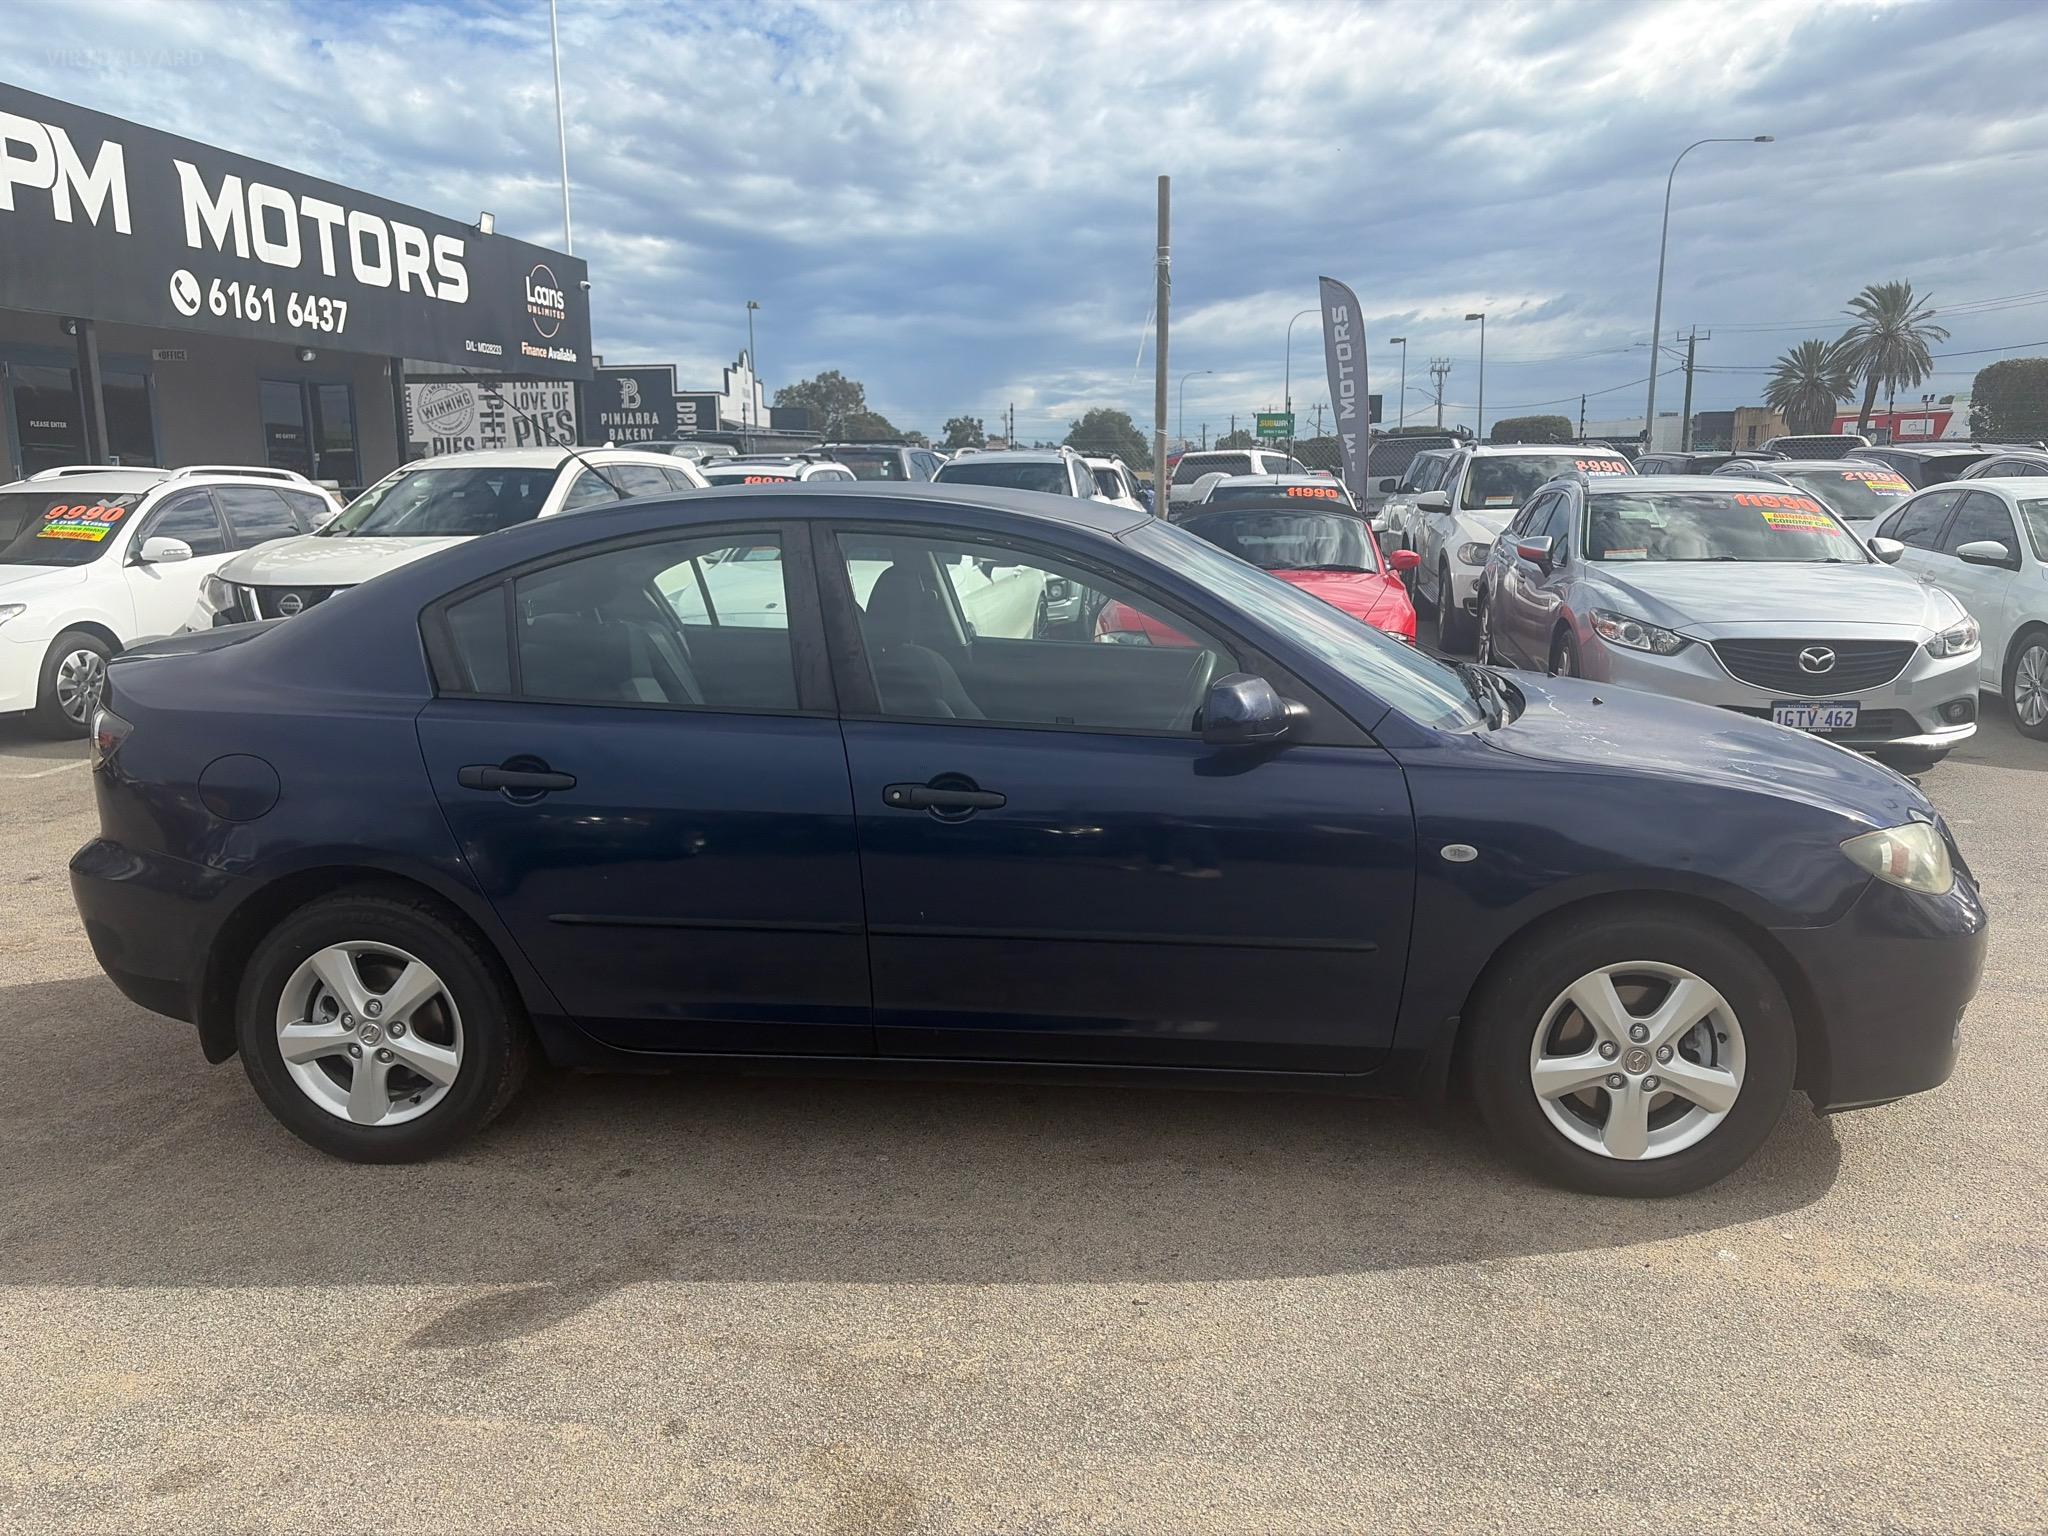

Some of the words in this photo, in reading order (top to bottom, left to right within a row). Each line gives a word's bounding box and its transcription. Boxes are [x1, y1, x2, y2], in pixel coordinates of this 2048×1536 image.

[173, 159, 470, 304] MOTORS
[525, 276, 565, 310] Loans
[208, 278, 276, 325] 6161
[287, 291, 348, 334] 6437
[527, 304, 565, 320] UNLIMITED
[161, 351, 186, 360] OFFICE
[521, 342, 548, 358] Finance
[548, 346, 577, 362] Available
[1332, 305, 1355, 420] MOTORS
[421, 392, 471, 420] WINNING
[512, 391, 547, 411] LOVE
[552, 391, 569, 411] OF
[30, 420, 50, 428] PLEASE
[50, 421, 67, 429] ENTER
[512, 409, 576, 447] PIES
[601, 412, 660, 426] PINJARRA
[609, 428, 654, 441] BAKERY
[1575, 460, 1627, 473] 8990
[1287, 487, 1338, 499] 11990
[1734, 493, 1820, 513] 11990
[44, 505, 126, 522] 9990
[1767, 518, 1813, 526] ECONOMY
